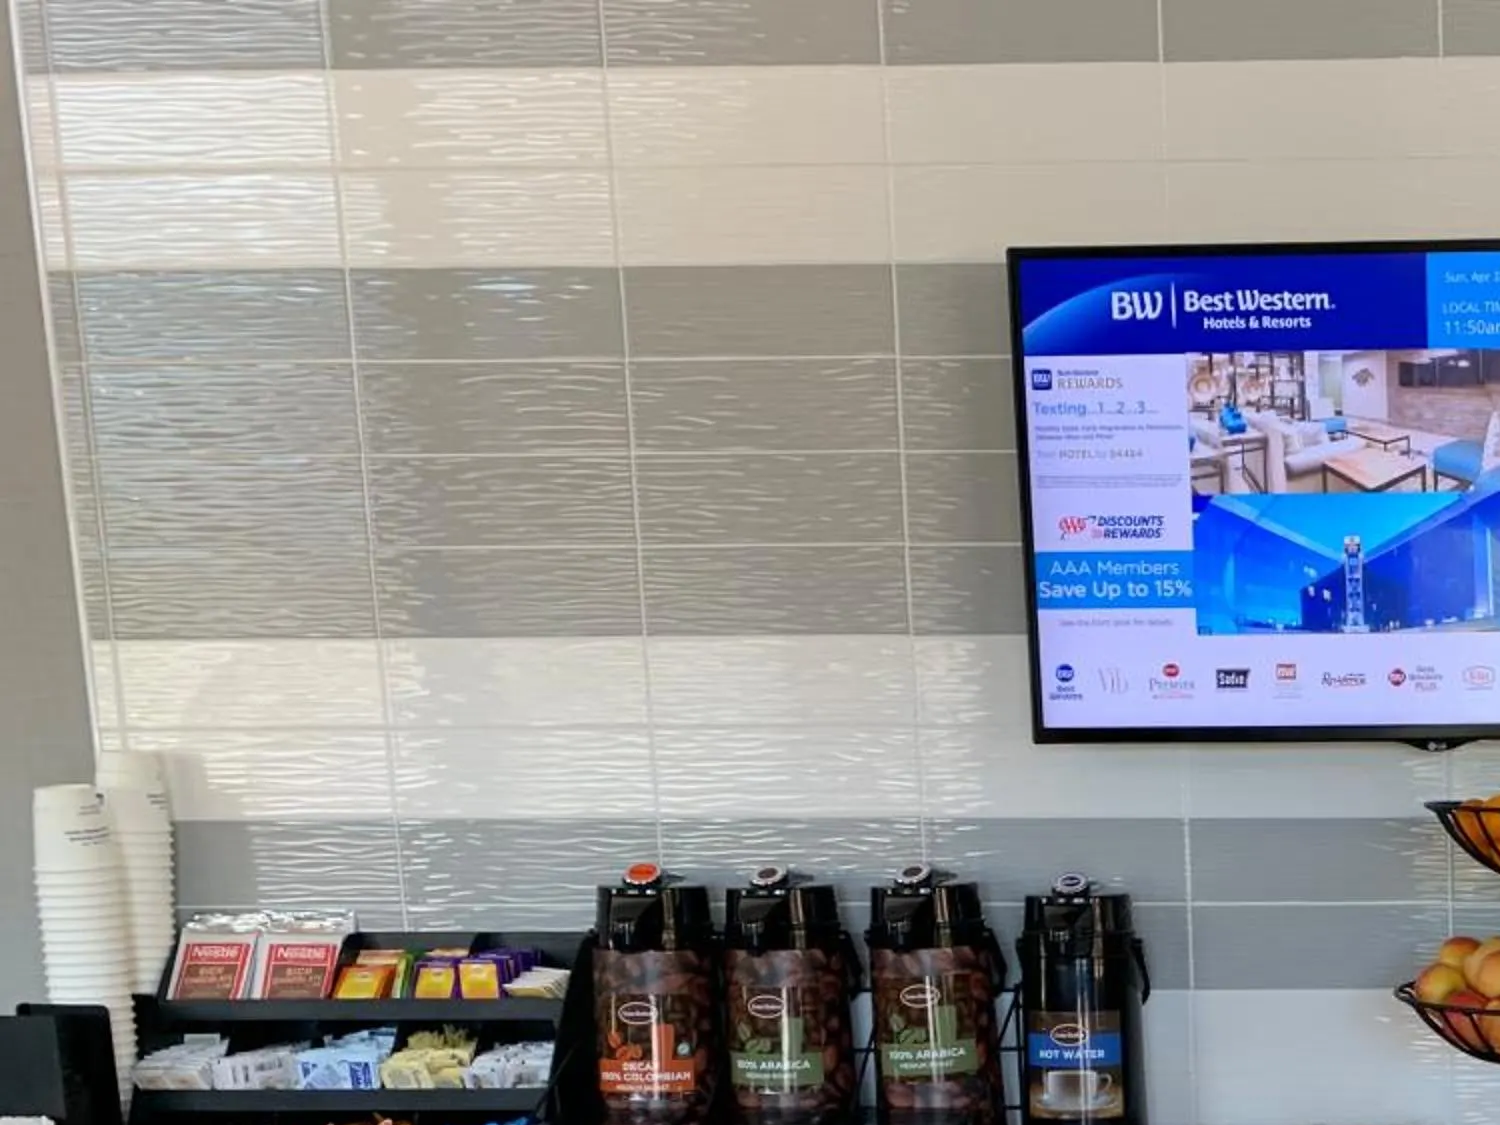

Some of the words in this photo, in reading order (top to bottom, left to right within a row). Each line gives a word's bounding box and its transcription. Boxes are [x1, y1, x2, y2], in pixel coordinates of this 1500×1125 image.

[1111, 291, 1163, 320] BW
[1183, 290, 1235, 312] Best
[1442, 302, 1480, 315] LOCAL
[1203, 316, 1246, 329] Hotels
[1249, 316, 1260, 328] &
[1262, 315, 1312, 328] Resorts
[1057, 378, 1124, 389] REWARDS
[1098, 516, 1164, 527] DISCOUNTS
[1104, 528, 1162, 539] REWARDS
[1051, 561, 1091, 575] AAA
[1098, 560, 1181, 575] Members
[1039, 582, 1087, 598] Save
[1093, 581, 1121, 600] Up
[1128, 581, 1149, 597] to
[1155, 580, 1193, 597] 15%
[915, 1047, 966, 1060] ARABICA
[1039, 1049, 1060, 1059] HOT
[1062, 1049, 1105, 1060] WATER
[622, 1062, 660, 1071] DECA
[623, 1071, 692, 1082] COLOMBIAN
